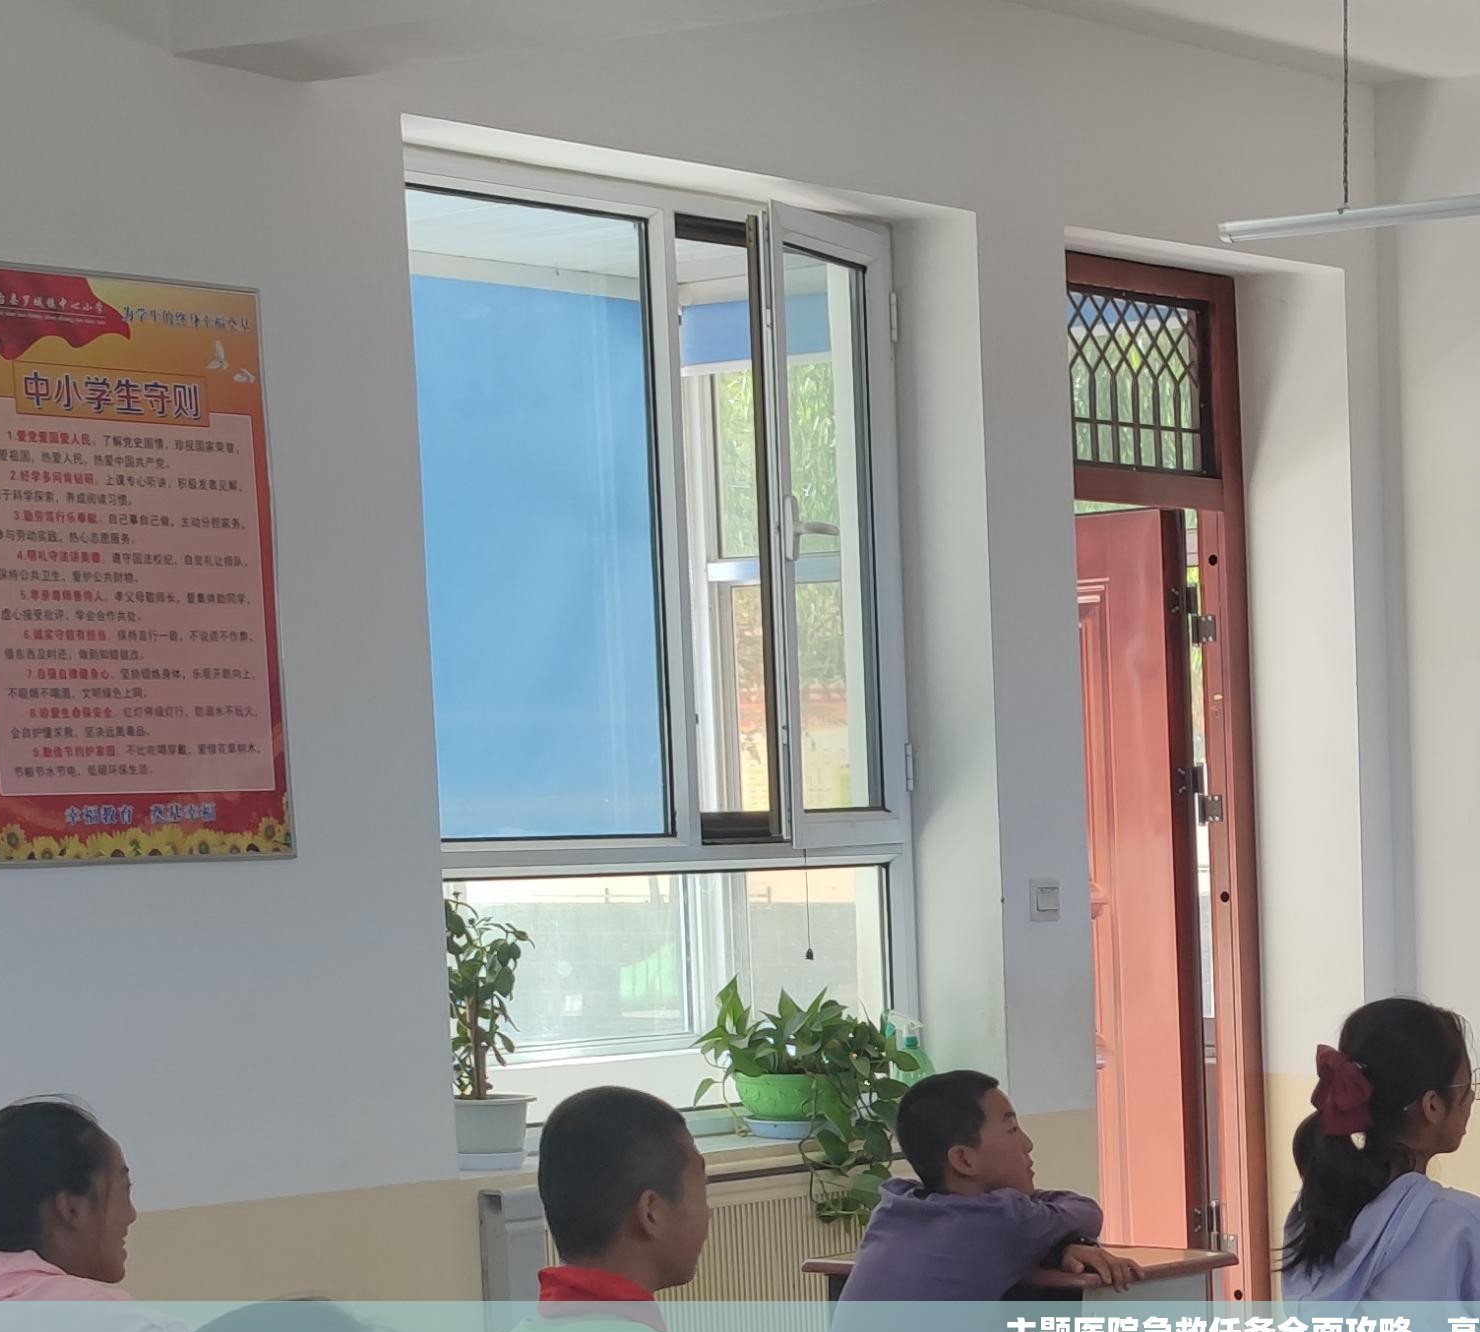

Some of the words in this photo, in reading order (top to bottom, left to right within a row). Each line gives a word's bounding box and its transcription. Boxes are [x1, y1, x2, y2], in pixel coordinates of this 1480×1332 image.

[22, 371, 202, 420] 中小学生守则
